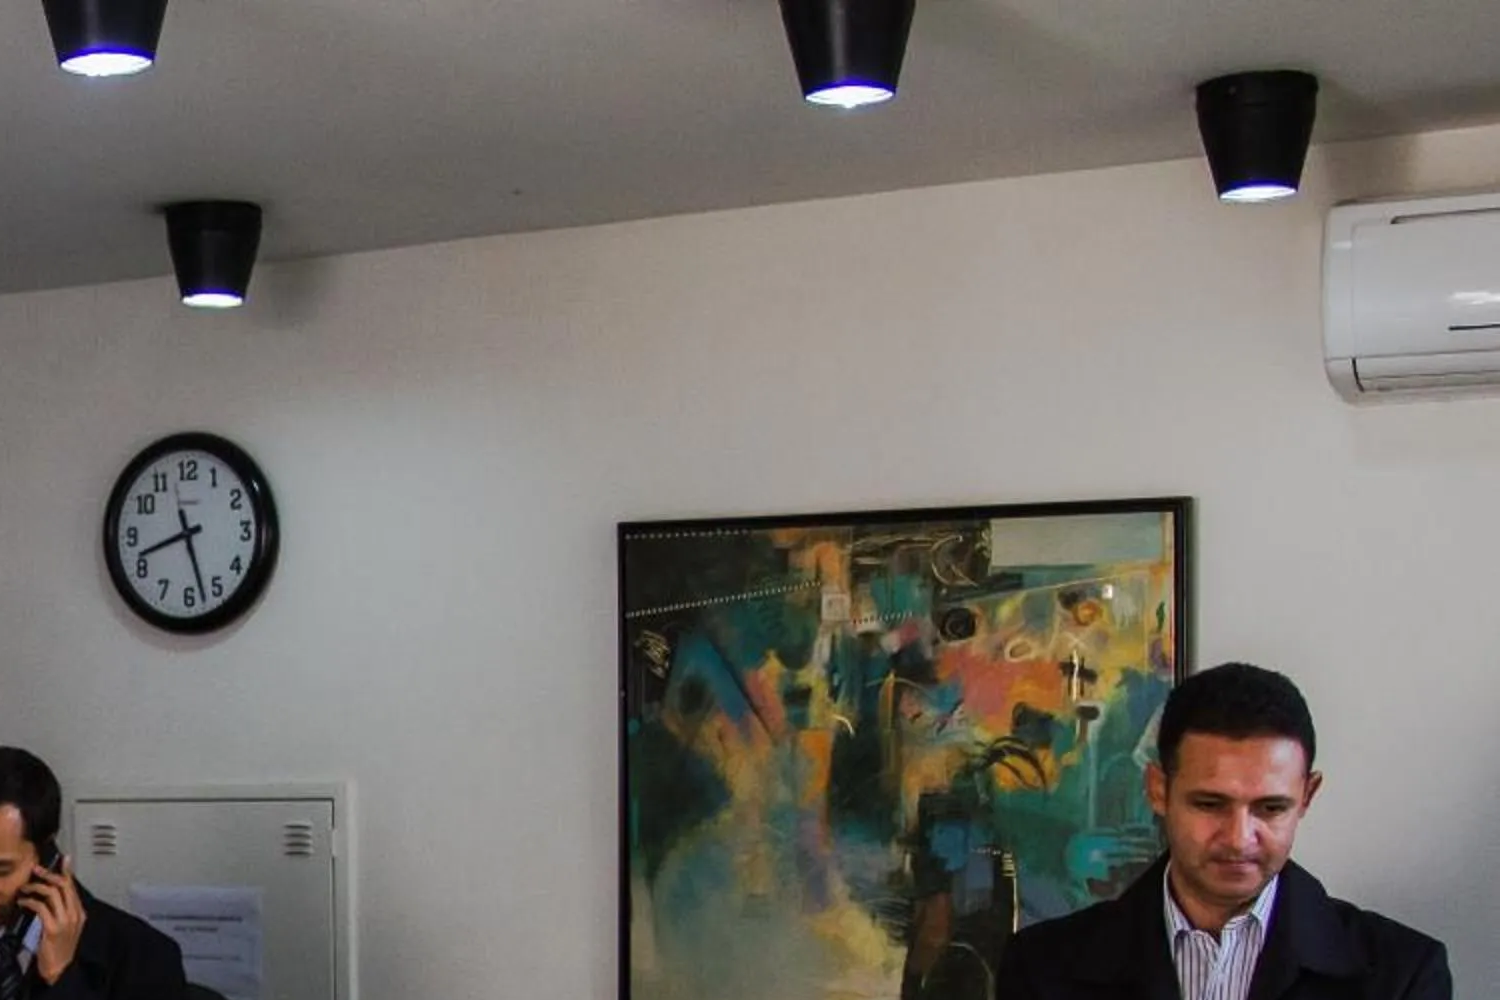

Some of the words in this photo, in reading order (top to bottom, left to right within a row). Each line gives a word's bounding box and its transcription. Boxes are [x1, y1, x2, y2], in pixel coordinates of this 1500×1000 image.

[178, 460, 199, 481] 12
[210, 467, 218, 488] 1
[153, 473, 168, 493] 11
[137, 494, 155, 515] 10
[230, 489, 242, 510] 2
[126, 526, 138, 548] 9
[240, 520, 252, 542] 3
[136, 557, 148, 578] 8
[230, 555, 243, 576] 4
[158, 580, 170, 601] 7
[211, 576, 224, 597] 5
[184, 587, 195, 608] 6
